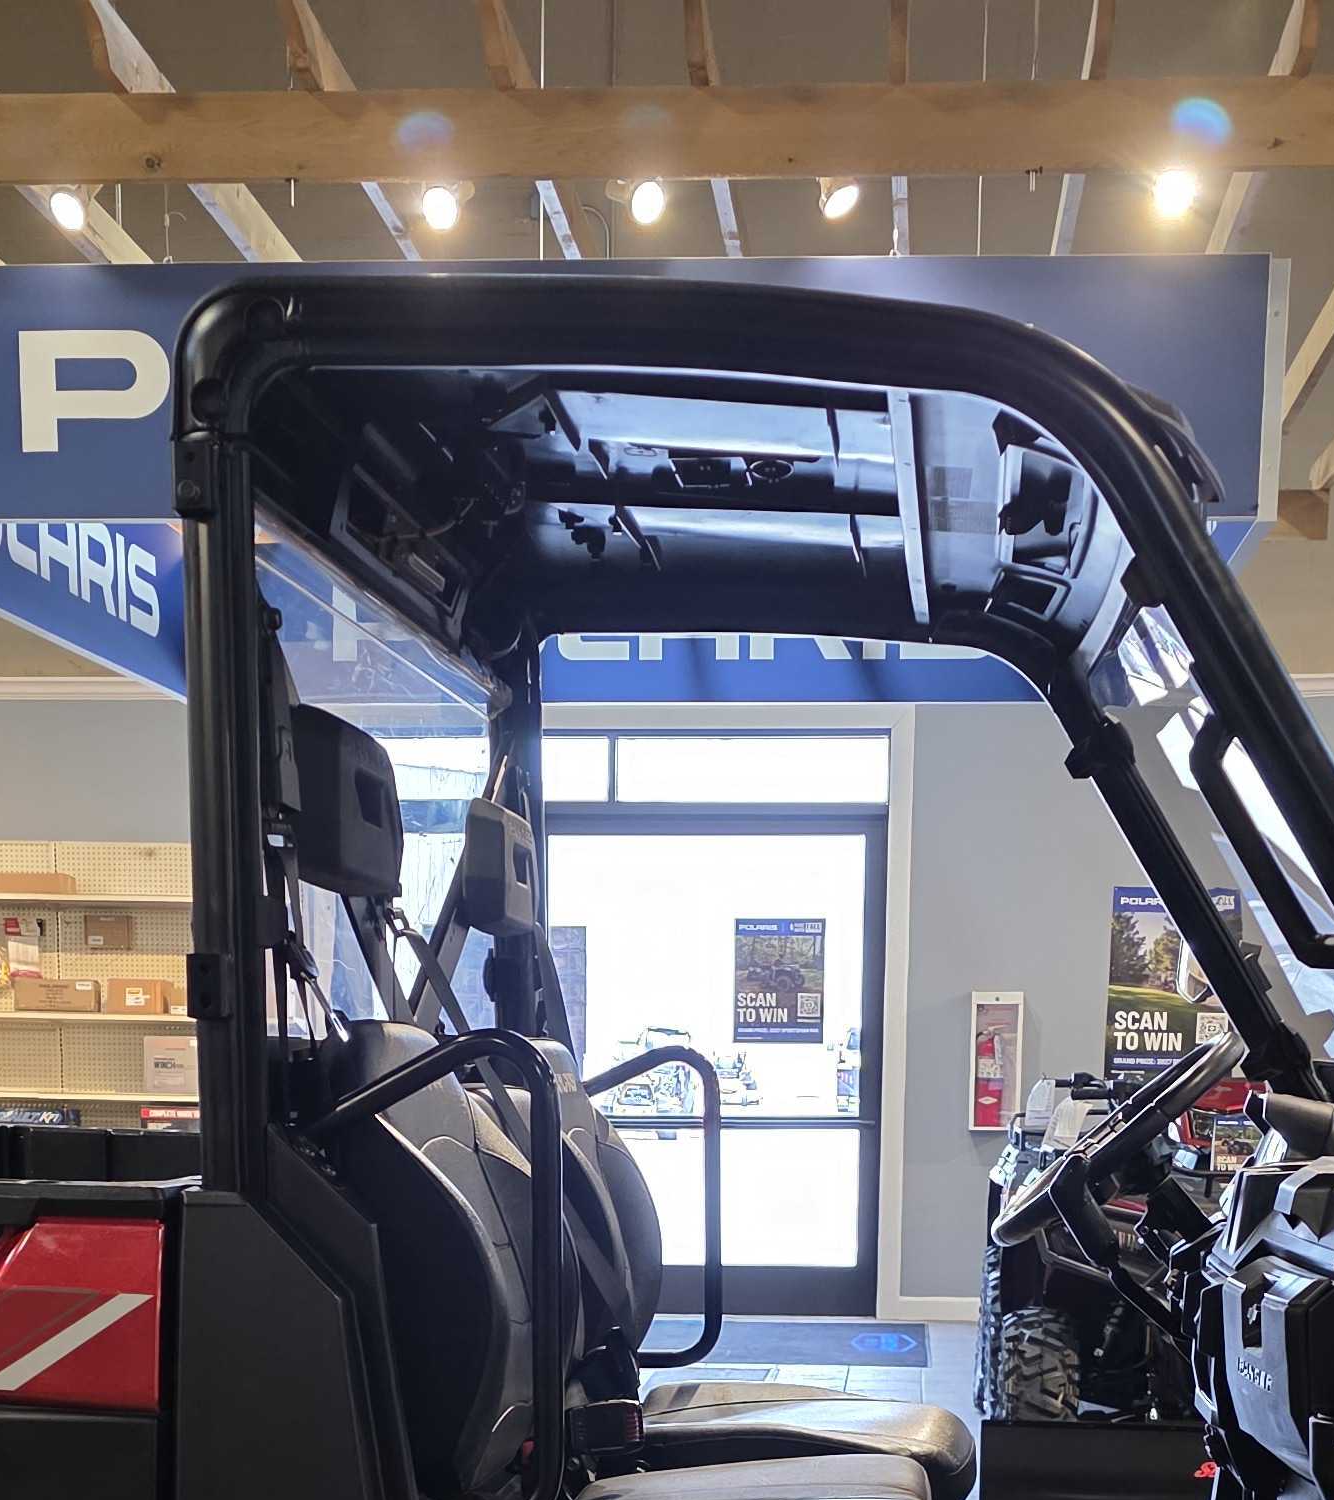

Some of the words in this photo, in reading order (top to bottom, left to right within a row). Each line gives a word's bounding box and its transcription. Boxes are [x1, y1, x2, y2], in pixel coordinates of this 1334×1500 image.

[737, 992, 777, 1007] SCAN
[737, 1008, 756, 1023] TO
[759, 1008, 788, 1023] WIN
[1114, 1011, 1168, 1031] SCAN
[1114, 1031, 1139, 1050] TO
[1144, 1032, 1183, 1051] WIN
